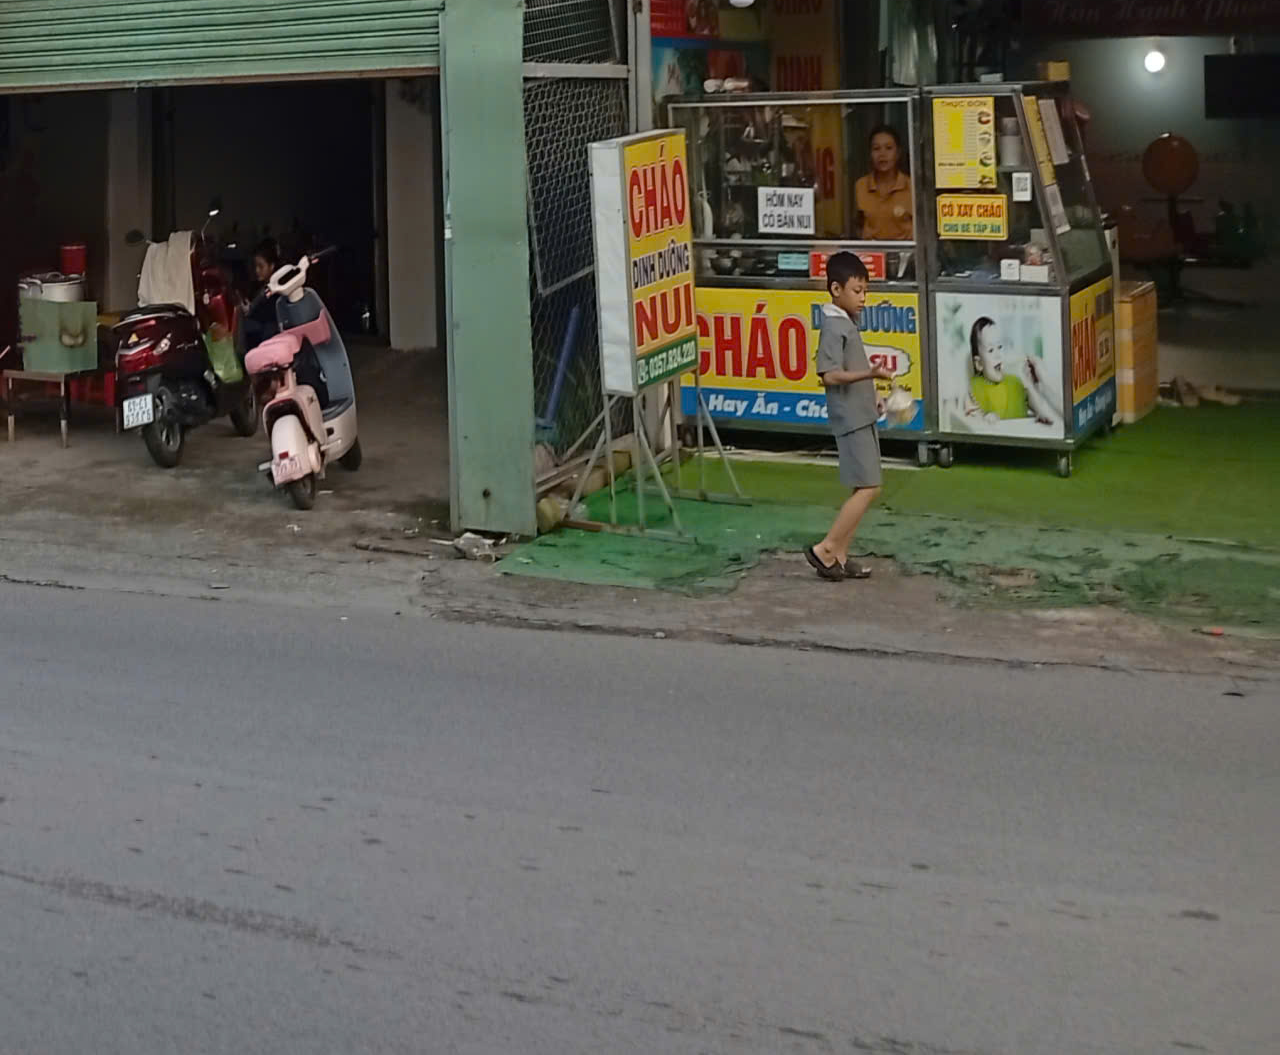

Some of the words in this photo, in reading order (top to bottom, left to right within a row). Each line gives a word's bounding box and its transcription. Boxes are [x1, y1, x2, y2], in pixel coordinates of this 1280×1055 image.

[629, 142, 686, 238] CHÁO
[787, 193, 804, 207] NAY
[632, 254, 656, 289] DINH
[635, 283, 694, 347] NUI
[709, 394, 749, 417] Hay
[751, 392, 779, 415] Ăn
